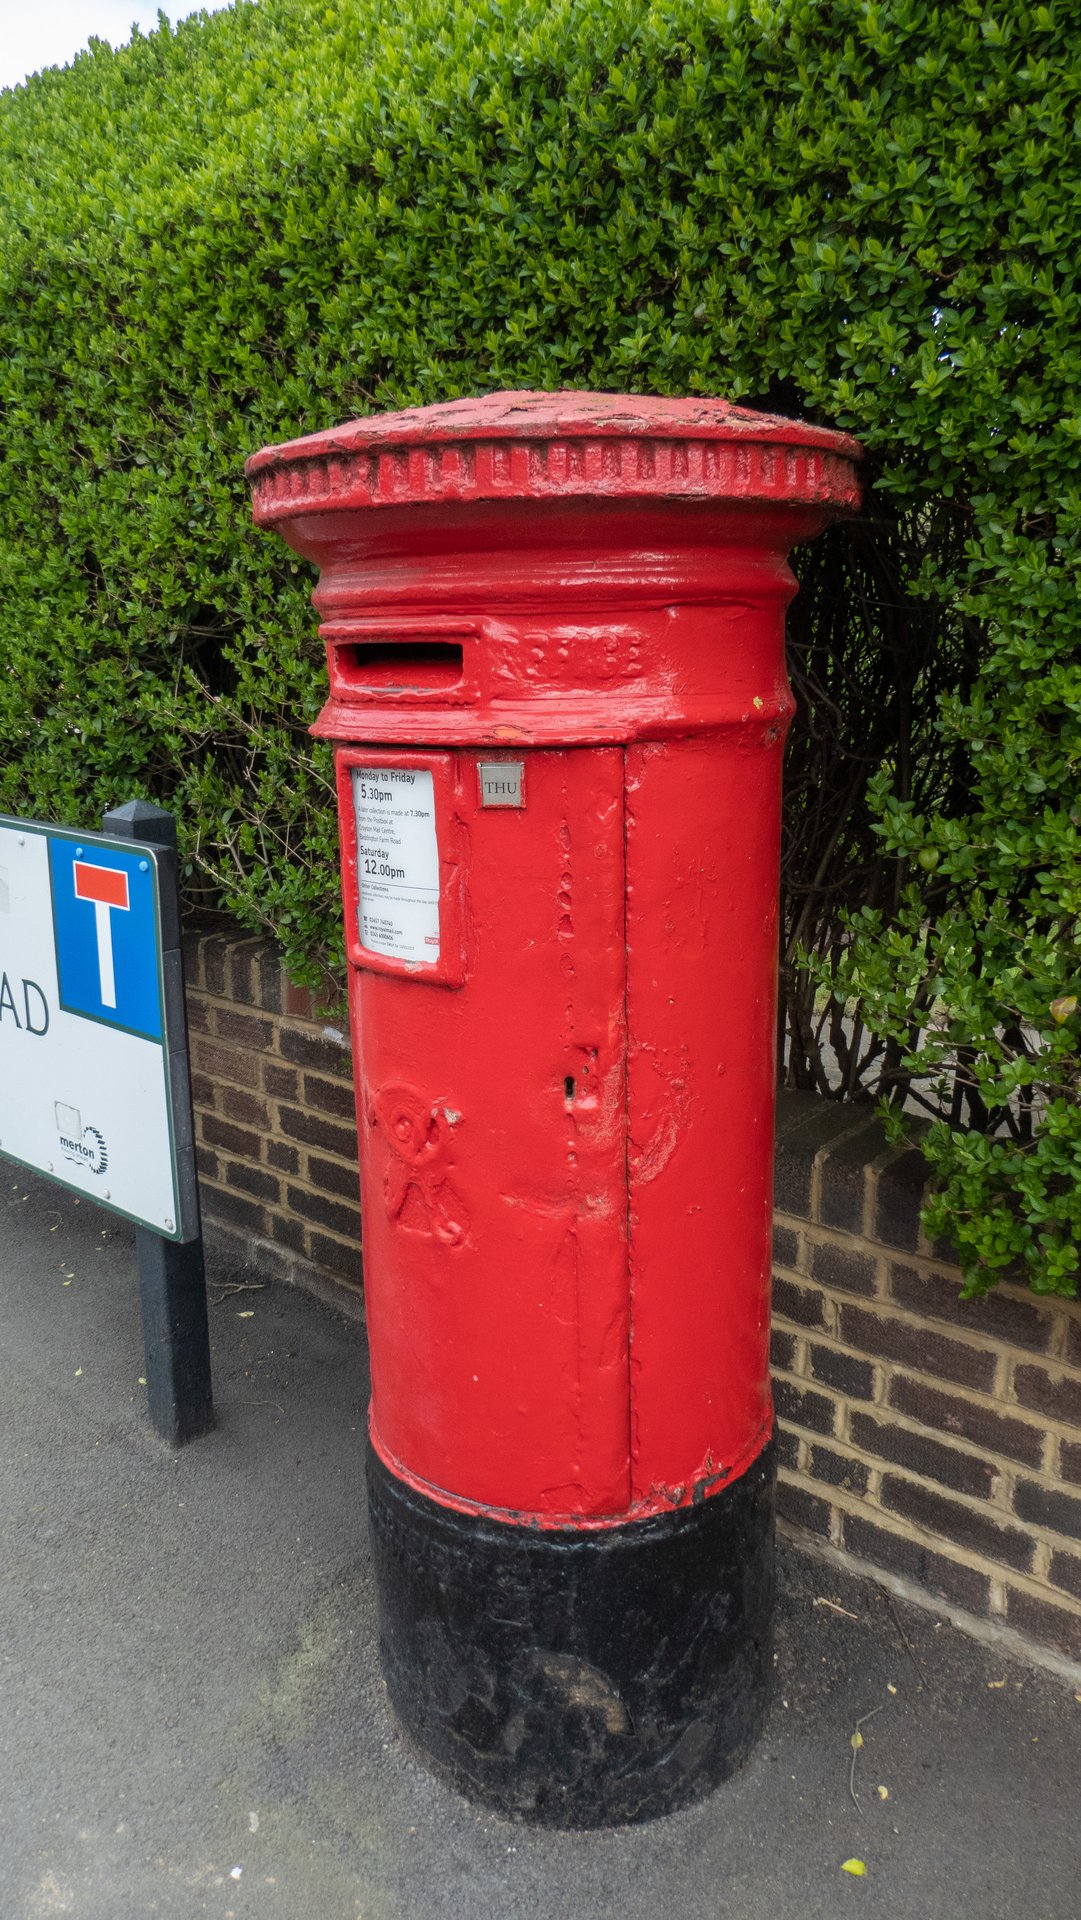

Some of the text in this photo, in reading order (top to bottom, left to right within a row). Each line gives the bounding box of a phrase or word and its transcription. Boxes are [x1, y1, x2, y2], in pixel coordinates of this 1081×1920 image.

[356, 770, 416, 785] Monday to Friday
[361, 784, 393, 803] 5.30pm
[484, 781, 517, 794] THU
[410, 810, 430, 818] 7.30pm
[360, 846, 389, 860] Saturday
[364, 859, 405, 879] 12.00pm
[60, 1136, 95, 1159] merton
